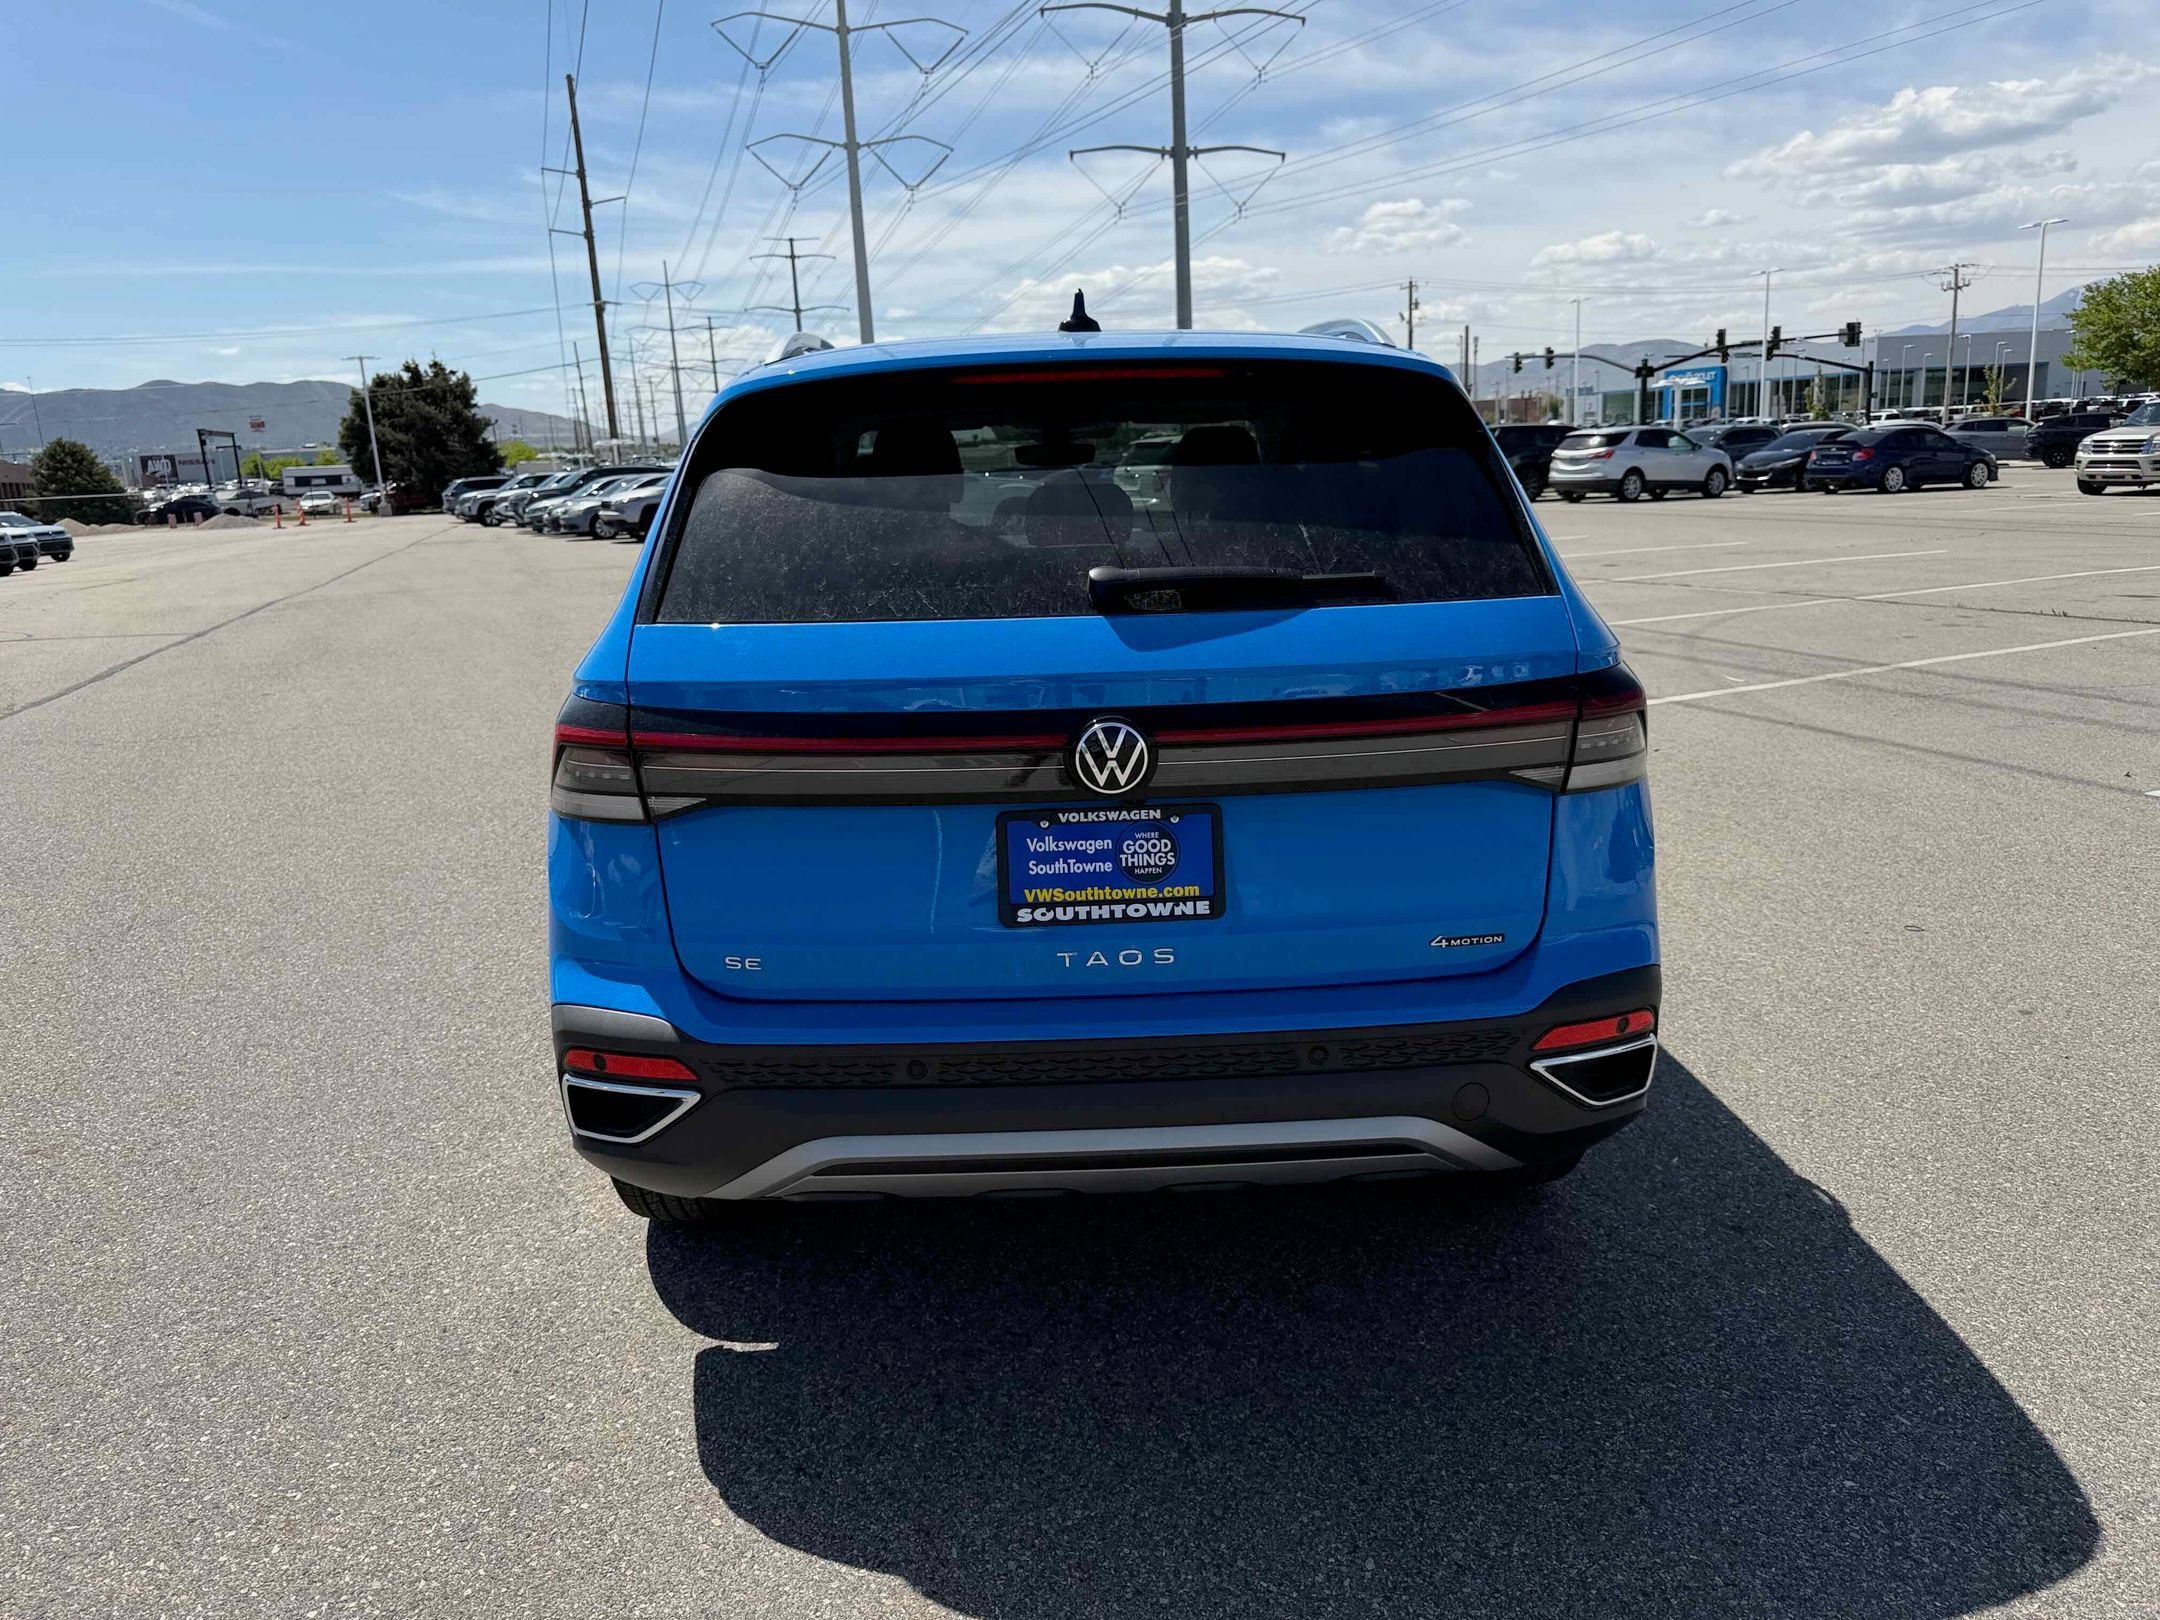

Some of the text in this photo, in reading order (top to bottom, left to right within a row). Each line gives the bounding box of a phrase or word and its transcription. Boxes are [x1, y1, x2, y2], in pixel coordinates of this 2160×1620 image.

[1058, 809, 1162, 823] VOLKSWAGEN
[1134, 831, 1160, 840] WHERE
[1026, 837, 1113, 854] Volkswagen
[1122, 839, 1172, 854] GOOD
[1028, 858, 1113, 875] SouthTowne
[1119, 852, 1176, 867] THINGS
[1134, 867, 1163, 875] HAPPEN
[1024, 885, 1200, 903] VWSouthtowne.com
[1016, 900, 1211, 923] SOUTHTOWNE
[1430, 935, 1503, 949] 4MOTION
[725, 956, 762, 971] SE
[1056, 948, 1175, 968] TAOS
